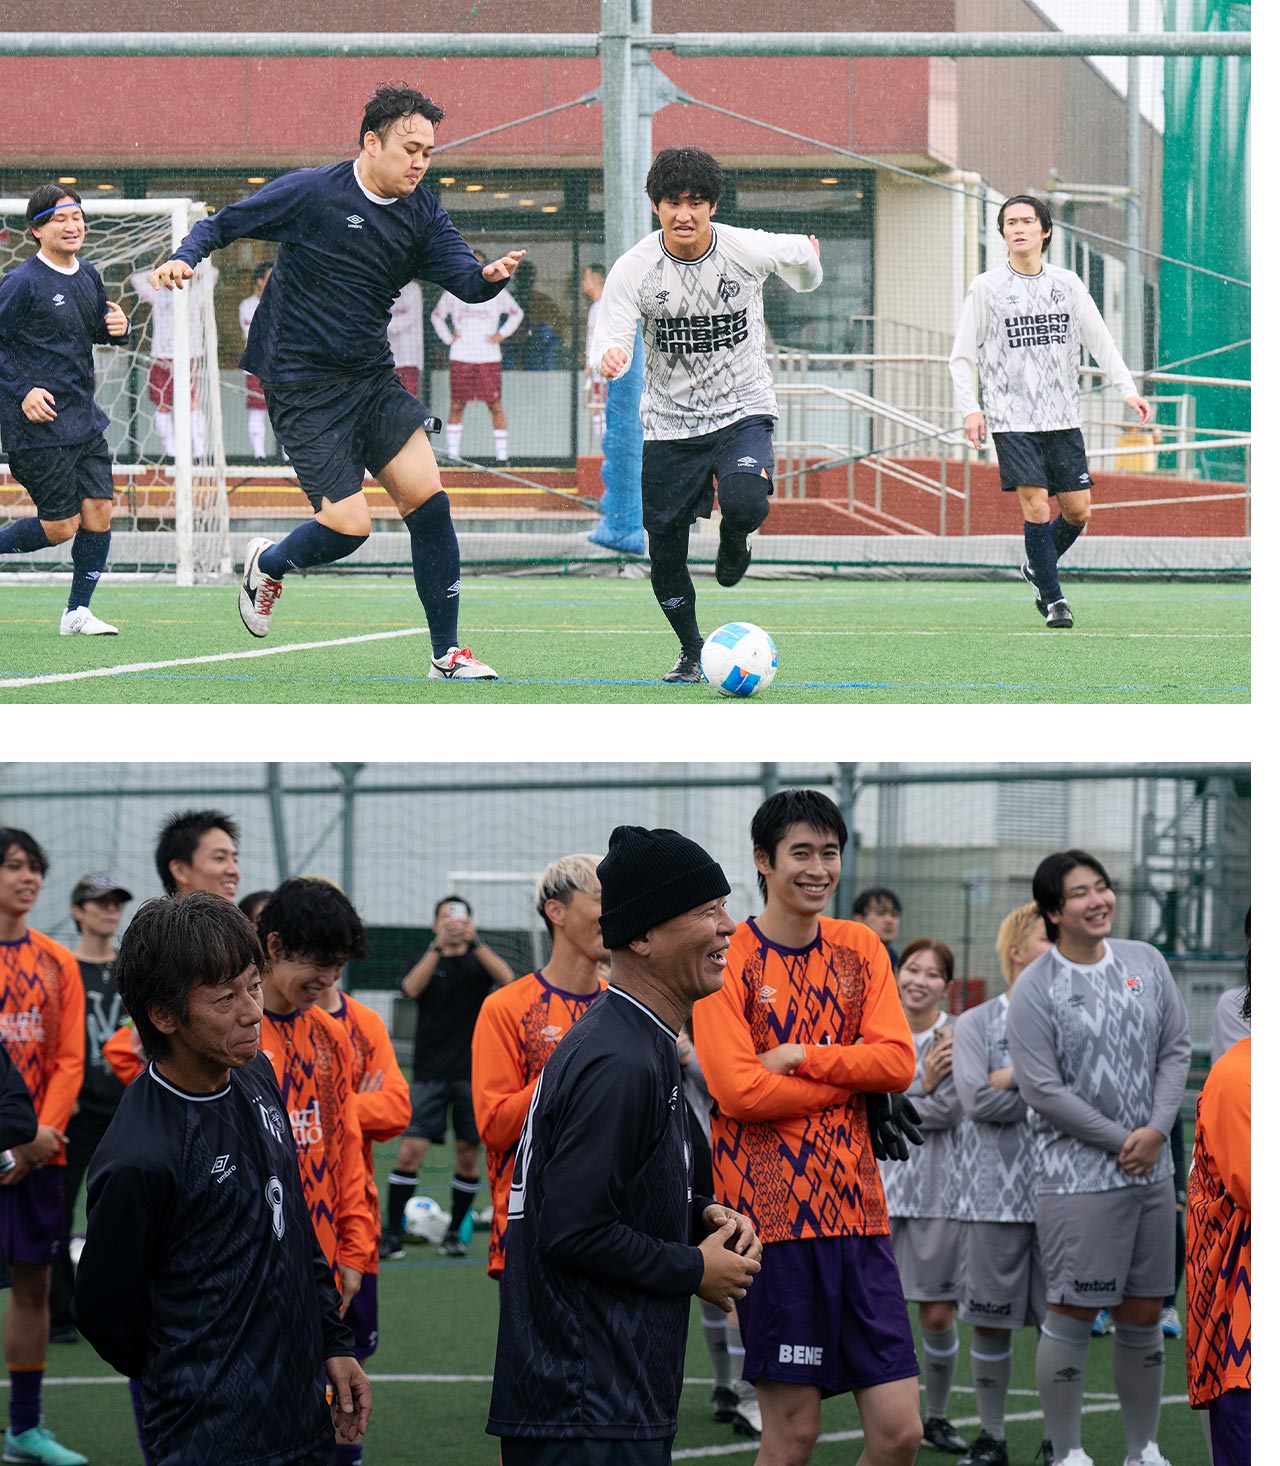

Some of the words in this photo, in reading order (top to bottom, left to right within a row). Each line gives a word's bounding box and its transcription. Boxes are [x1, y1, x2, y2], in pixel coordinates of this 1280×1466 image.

[1004, 313, 1070, 328] UMBRO
[1006, 324, 1068, 338] UMBRO
[1008, 335, 1067, 348] UMBRO
[216, 1164, 237, 1184] umbro
[778, 1343, 824, 1366] BENE
